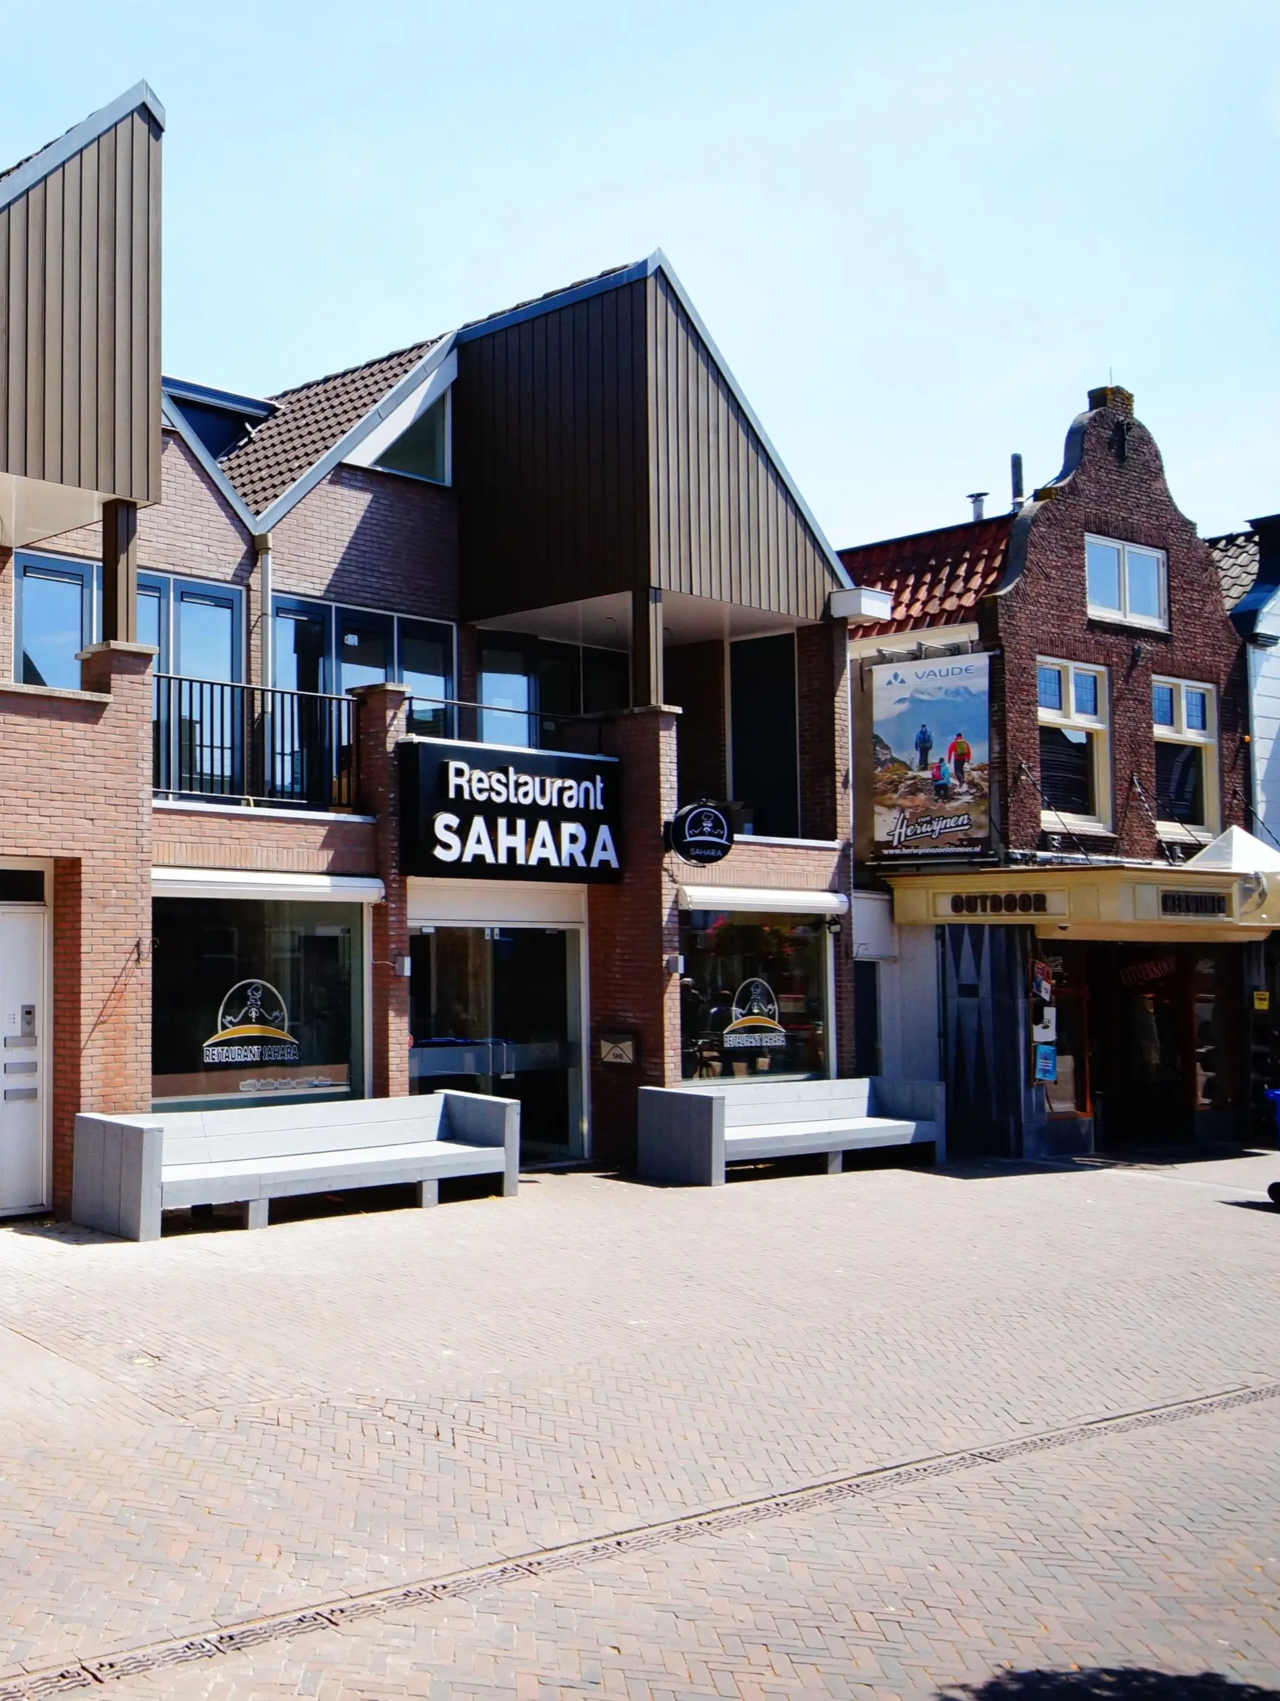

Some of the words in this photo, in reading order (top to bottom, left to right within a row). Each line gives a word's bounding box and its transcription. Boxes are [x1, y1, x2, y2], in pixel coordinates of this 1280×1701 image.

[914, 664, 975, 680] VAUDE
[448, 760, 605, 810] Restaurant
[433, 811, 620, 869] SAHARA
[690, 847, 723, 857] SAHARA
[950, 893, 1047, 914] OUTDOOR
[203, 1045, 261, 1062] RESTAURANT
[262, 1044, 300, 1060] SAHARA
